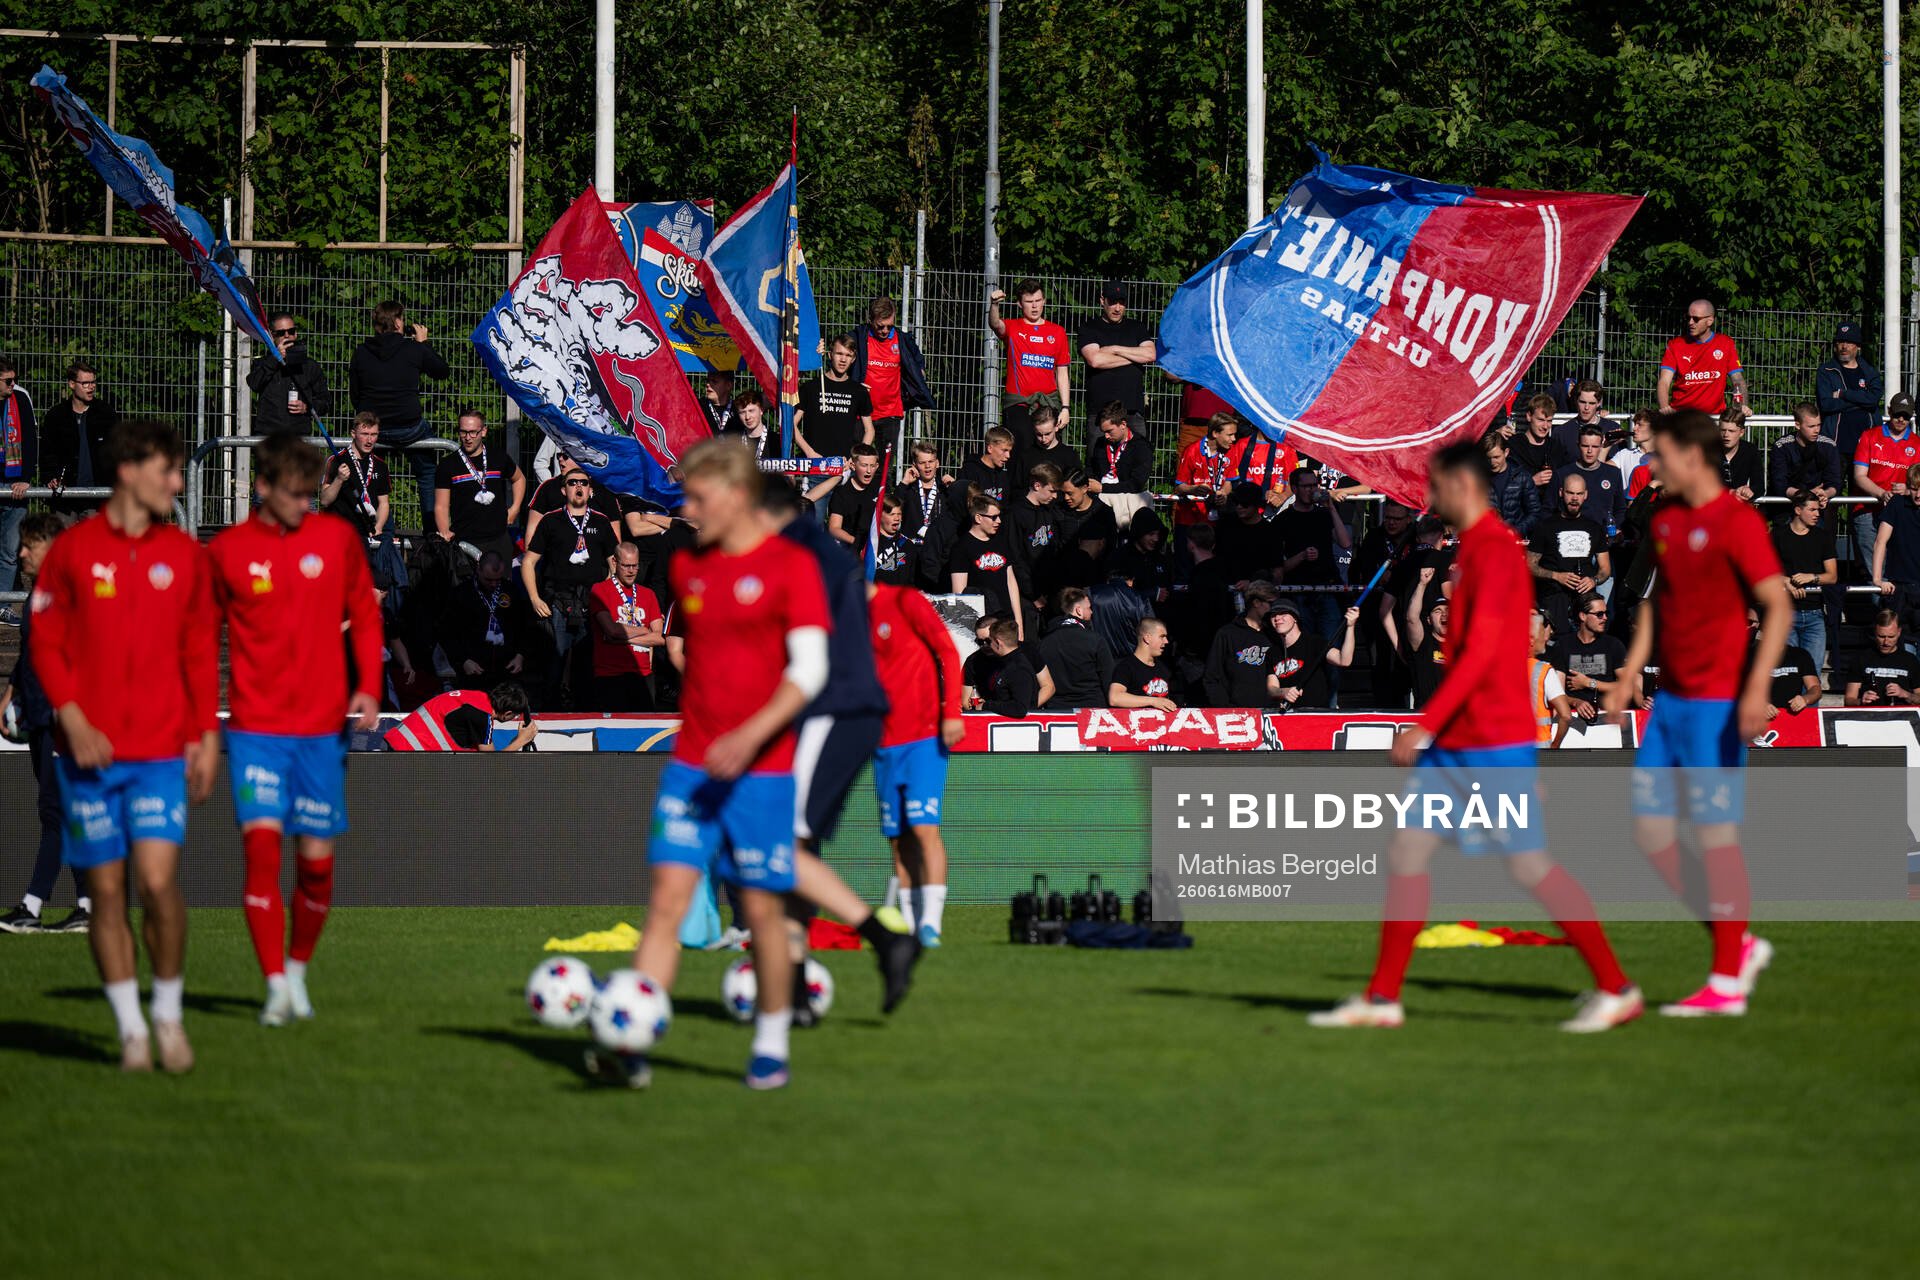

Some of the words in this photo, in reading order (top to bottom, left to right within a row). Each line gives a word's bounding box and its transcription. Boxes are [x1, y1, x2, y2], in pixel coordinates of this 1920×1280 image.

[1684, 370, 1711, 380] akea
[799, 459, 813, 472] IF
[1084, 708, 1259, 745] ACAB
